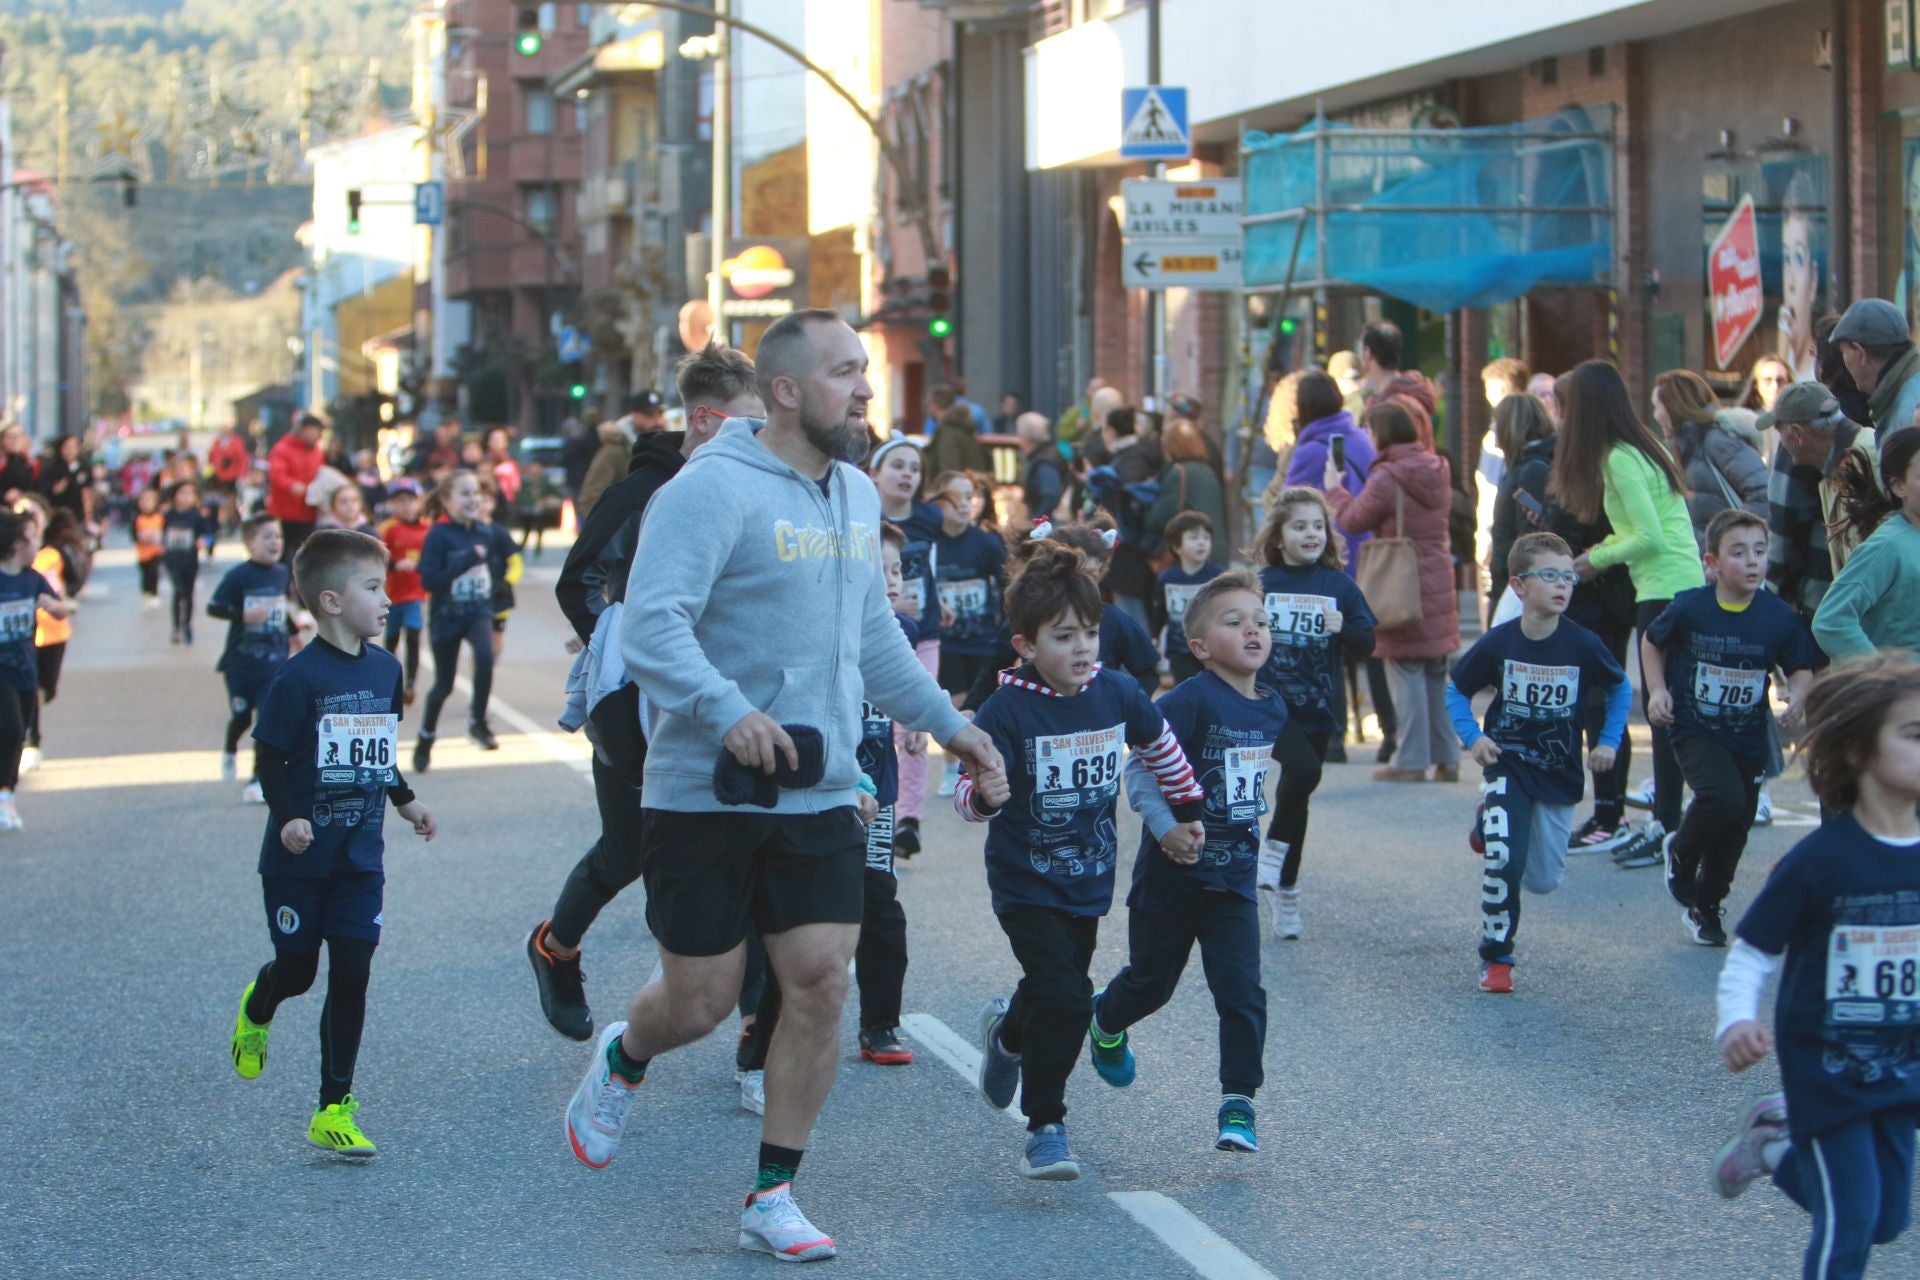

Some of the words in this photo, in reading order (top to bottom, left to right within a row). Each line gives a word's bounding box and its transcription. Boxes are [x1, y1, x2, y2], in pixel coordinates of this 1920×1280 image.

[1128, 201, 1153, 214] LA
[1131, 219, 1198, 233] AVILES
[1290, 611, 1325, 634] 759
[323, 692, 357, 705] diciembre
[1525, 683, 1568, 706] 629
[1719, 685, 1754, 705] 705
[333, 717, 349, 727] SAN
[353, 716, 388, 727] SILVESTRE
[349, 737, 389, 767] 646
[1052, 737, 1071, 750] SAN
[1241, 751, 1255, 761] SAN
[1072, 751, 1117, 789] 639
[1875, 958, 1916, 998] 68
